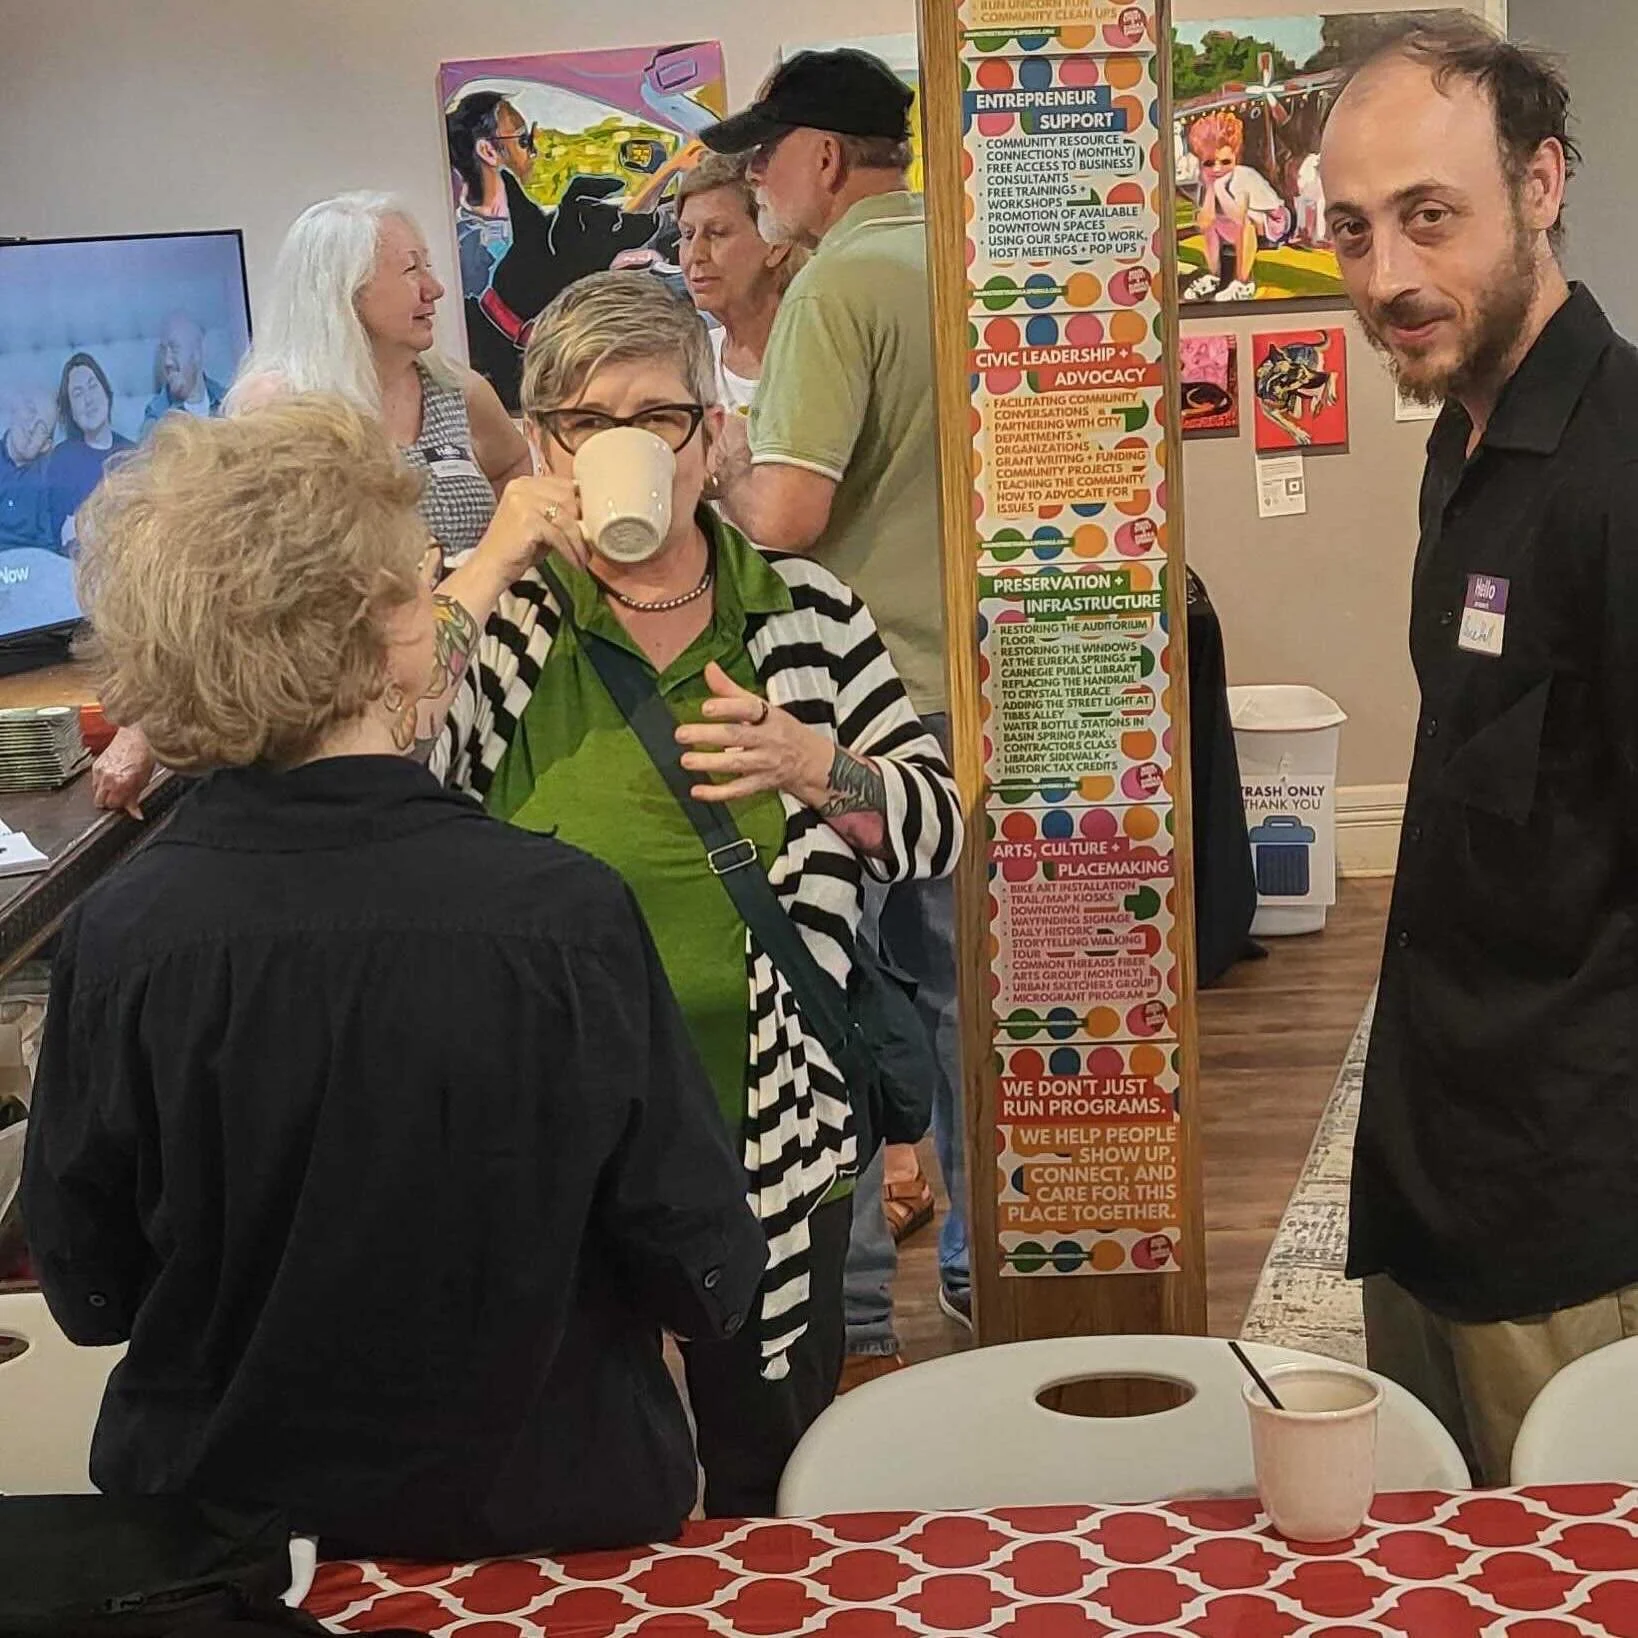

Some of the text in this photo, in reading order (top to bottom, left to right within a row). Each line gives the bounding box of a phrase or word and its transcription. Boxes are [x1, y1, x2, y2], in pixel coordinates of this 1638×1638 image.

[981, 11, 1050, 22] COMMUNITY
[1055, 9, 1093, 20] CLEAN
[976, 91, 1097, 109] ENTREPRENEUR
[1040, 112, 1114, 129] SUPPORT
[987, 135, 1119, 149] COMMUNITY RESOURCE
[987, 146, 1135, 161] CONNECTIONS (MONTHLY)
[987, 159, 1133, 173] FREE ACCESS TO BUSINESS
[988, 173, 1068, 185] CONSULTANTS
[988, 187, 1013, 197] FREE
[1016, 185, 1076, 196] TRAININGS
[988, 198, 1062, 209] WORKSHOPS
[989, 207, 1138, 222] PROMOTION OF AVAILABLE
[989, 220, 1105, 234] DOWNTOWN SPACES
[989, 235, 1023, 246] USING
[1027, 234, 1051, 244] OUR
[1055, 233, 1089, 243] SPACE
[1092, 232, 1105, 241] TO
[989, 247, 1019, 258] HOST
[1022, 245, 1077, 256] MEETINGS
[1090, 244, 1112, 254] POP
[1116, 243, 1137, 253] UPS
[976, 352, 1018, 367] CIVIC
[1023, 348, 1115, 365] LEADERSHIP
[1055, 368, 1146, 385] ADVOCACY
[994, 393, 1138, 408] FACILITATING COMMUNITY
[994, 408, 1088, 419] CONVERSATIONS
[995, 417, 1121, 431] PARTNERING WITH CITY
[996, 431, 1073, 443] DEPARTMENTS
[996, 442, 1089, 455] ORGANIZATIONS
[996, 456, 1032, 466] GRANT
[1036, 454, 1083, 464] WRITING
[1096, 451, 1145, 462] FUNDING
[997, 464, 1123, 478] COMMUNITY PROJECTS
[997, 475, 1145, 490] TEACHING THE COMMUNITY
[998, 487, 1128, 501] HOW TO ADVOCATE FOR
[998, 502, 1034, 513] ISSUES
[994, 575, 1110, 593] PRESERVATION
[1475, 577, 1496, 599] Hello
[1027, 594, 1161, 613] INFRASTRUCTURE
[1001, 621, 1147, 635] RESTORING THE AUDITORIUM
[1001, 636, 1035, 645] FLOOR
[1001, 642, 1137, 656] RESTORING THE WINDOWS
[1002, 653, 1126, 667] AT THE EUREKA SPRINGS
[1002, 664, 1136, 678] CARNEGIE PUBLIC LIBRARY
[1002, 675, 1136, 689] REPLACING THE HANDRAIL
[1002, 687, 1110, 699] TO CRYSTAL TERRACE
[1003, 695, 1149, 710] ADDING THE STREET LIGHT AT
[1003, 710, 1064, 720] TIBBS ALLEY
[1003, 717, 1144, 731] WATER BOTTLE STATIONS IN
[1004, 730, 1105, 742] BASIN SPRING PARK
[1004, 740, 1117, 752] CONTRACTORS CLASS
[1005, 752, 1100, 763] LIBRARY SIDEWALK
[1005, 761, 1117, 774] HISTORIC TAX CREDITS
[1288, 786, 1324, 796] ONLY
[1244, 799, 1320, 810] THANK YOU
[993, 844, 1037, 858] ARTS,
[1041, 842, 1107, 856] CULTURE
[1059, 860, 1169, 877] PLACEMAKING
[1011, 881, 1135, 893] BIKE ART INSTALLATION
[1073, 893, 1114, 902] KIOSKS
[1011, 905, 1079, 915] DOWNTOWN
[1012, 913, 1130, 925] WAYFINDING SIGNAGE
[1012, 926, 1093, 936] DAILY HISTORIC
[1012, 935, 1141, 948] STORYTELLING WALKING
[1013, 950, 1041, 959] TOUR
[1012, 958, 1146, 969] COMMON THREADS FIBER
[1013, 968, 1143, 980] ARTS GROUP (MONTHLY)
[1013, 979, 1153, 991] URBAN SKETCHERS GROUP
[1013, 991, 1143, 1002] MICROGRANT PROGRAM
[1003, 1079, 1147, 1096] WE DON'T JUST
[1004, 1098, 1166, 1116] RUN PROGRAMS.
[1020, 1126, 1176, 1144] WE HELP PEOPLE
[1080, 1146, 1176, 1162] SHOW UP,
[1031, 1165, 1176, 1184] CONNECT, AND
[1036, 1184, 1176, 1202] CARE FOR THIS
[1008, 1203, 1176, 1222] PLACE TOGETHER.
